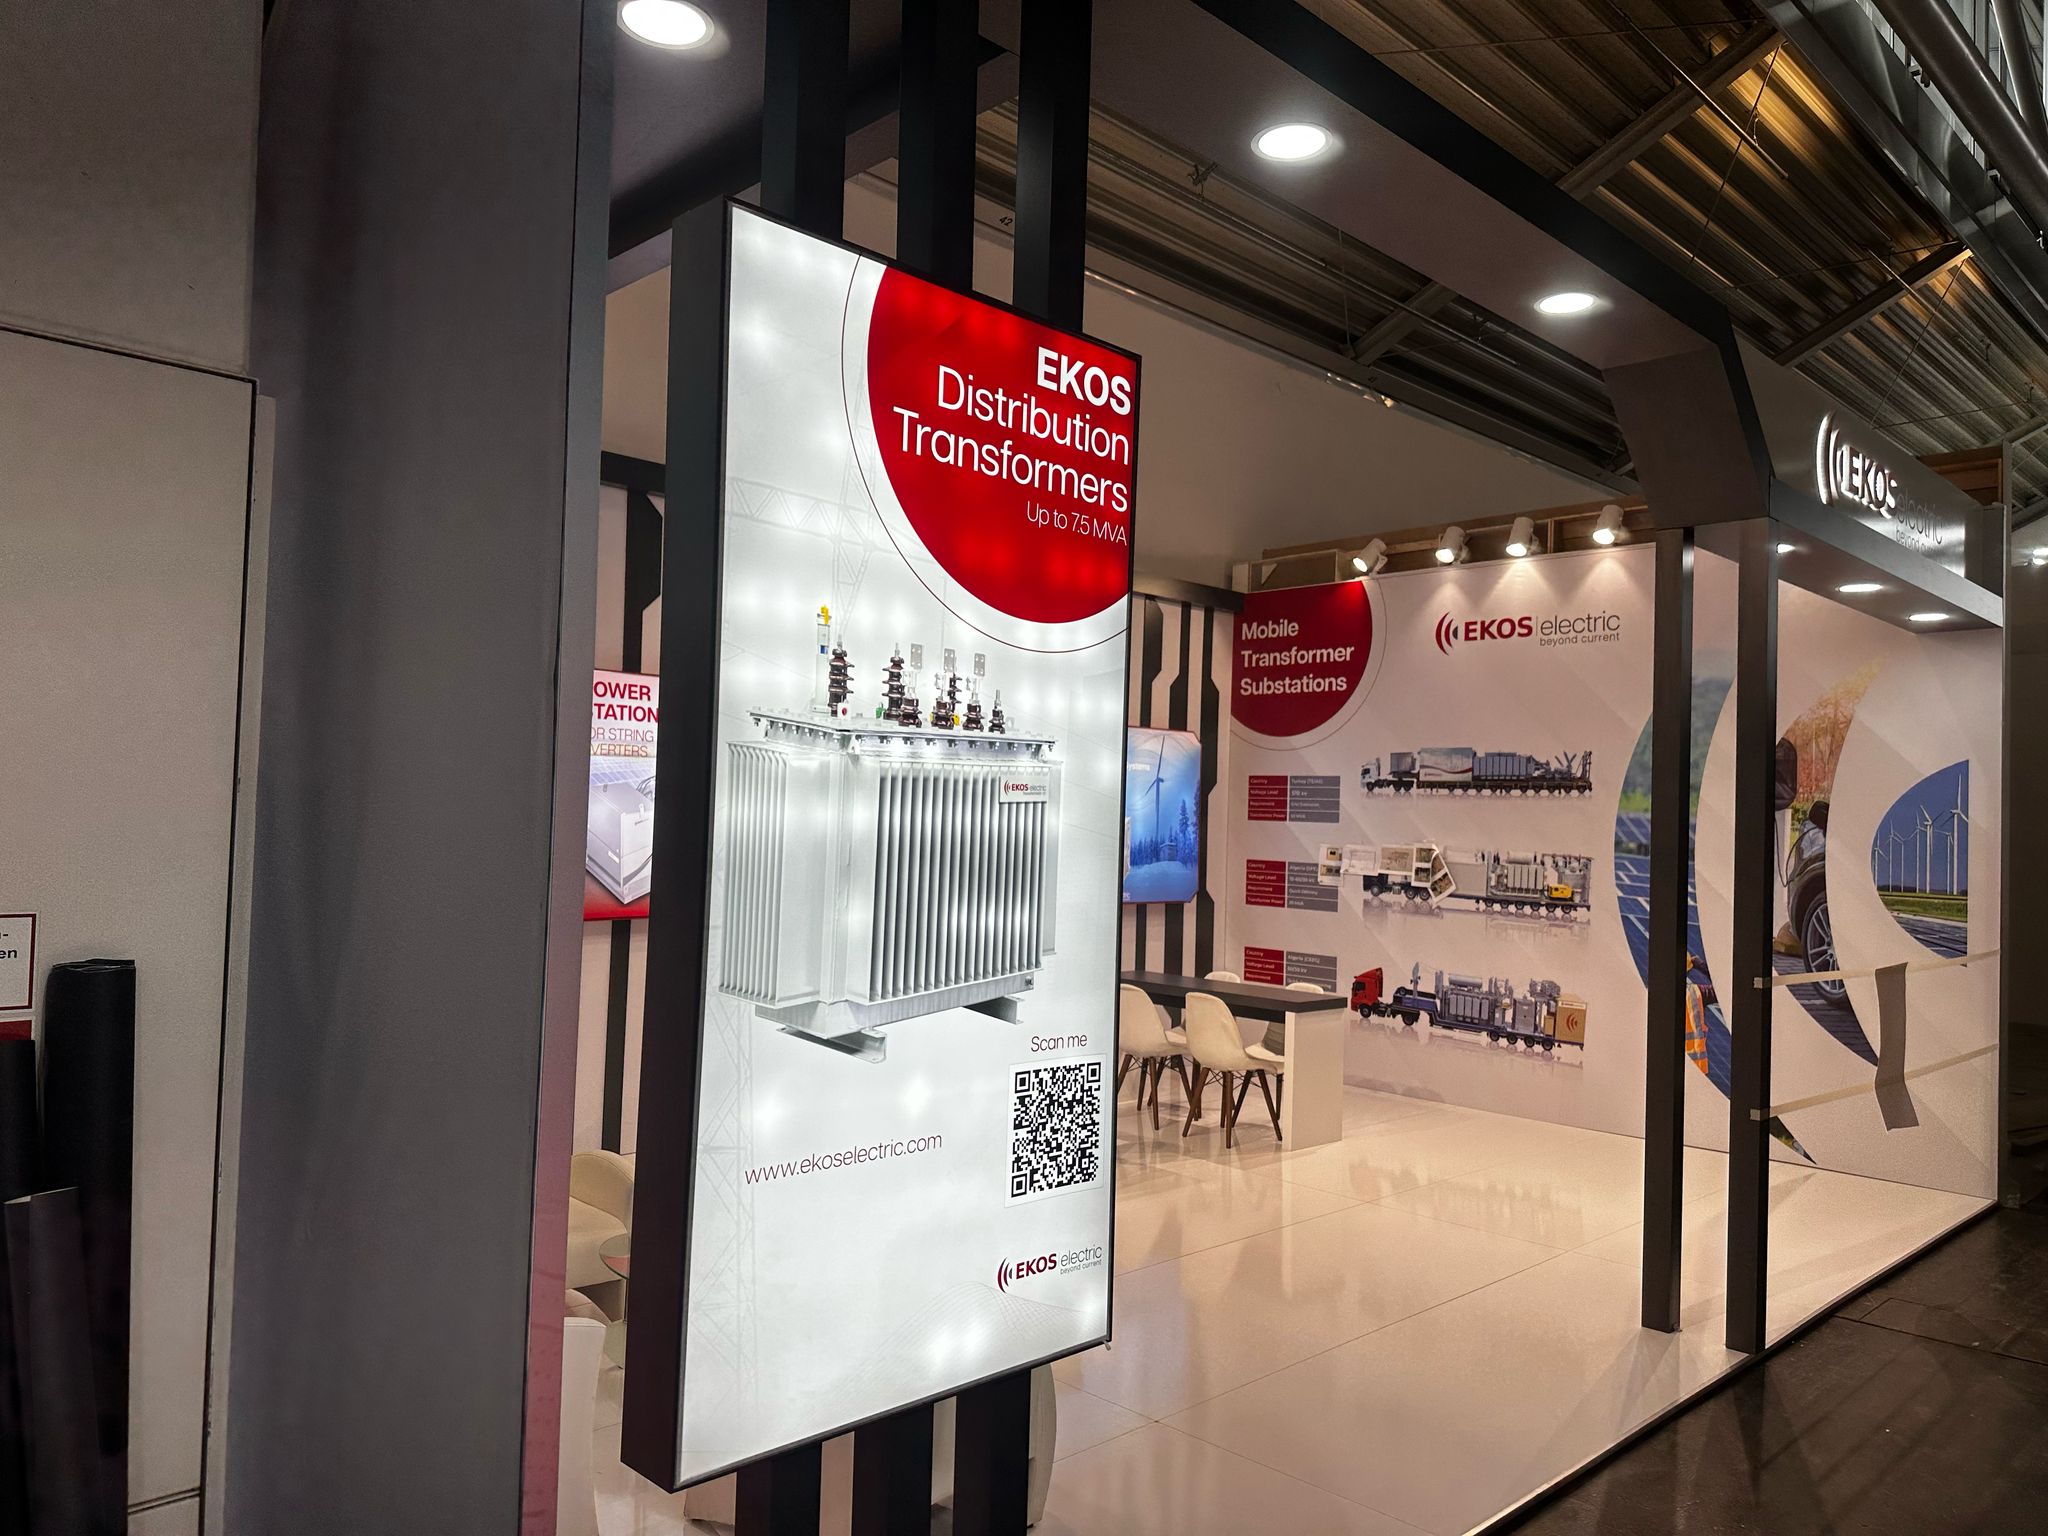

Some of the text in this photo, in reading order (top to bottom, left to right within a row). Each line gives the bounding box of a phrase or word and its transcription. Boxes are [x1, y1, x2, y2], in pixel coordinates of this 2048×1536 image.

[1037, 346, 1131, 416] EKOS
[938, 364, 1129, 466] Distribution
[893, 406, 1129, 513] Transformers
[1846, 446, 1943, 545] EKOS electric
[1027, 500, 1127, 546] Up to 7.5 MVA
[1241, 619, 1299, 640] Mobile
[1464, 610, 1621, 641] EKOS electric
[1540, 633, 1620, 647] beyond current
[1241, 646, 1354, 668] Transformer
[1240, 674, 1347, 696] Substations
[608, 727, 653, 742] STRING
[1011, 783, 1029, 792] EKOS
[1031, 1034, 1088, 1052] Scan me
[745, 1134, 942, 1185] www.ekoselectric.com
[1016, 1244, 1103, 1280] EKOS electric
[1060, 1258, 1103, 1275] beyond current
